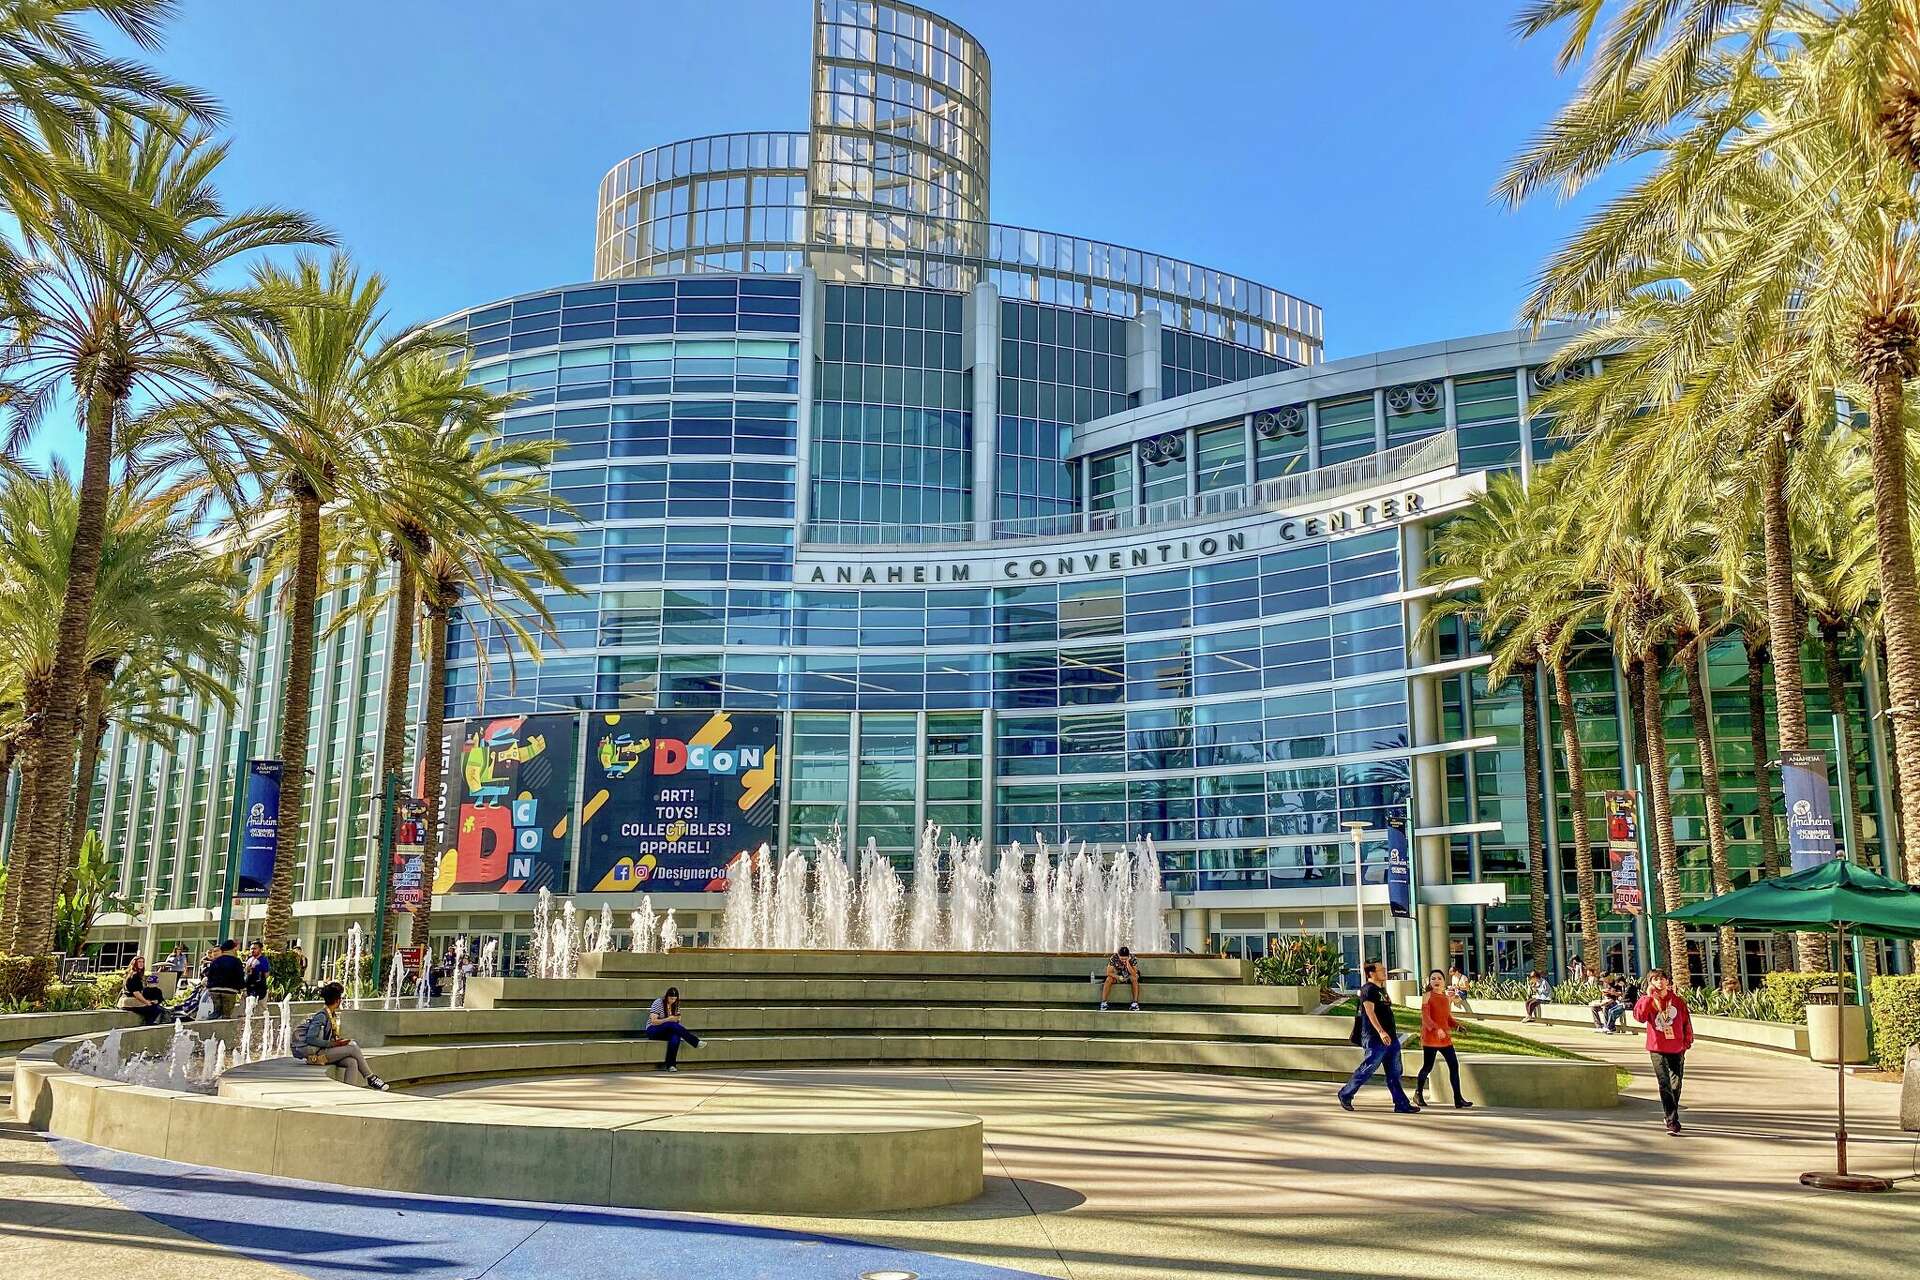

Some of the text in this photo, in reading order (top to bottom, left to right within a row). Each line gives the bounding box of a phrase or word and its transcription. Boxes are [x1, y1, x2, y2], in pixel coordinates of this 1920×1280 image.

[811, 492, 1419, 583] ANAHEIM CONVENTION CENTER
[653, 738, 760, 775] DCON
[661, 789, 695, 802] ART!
[656, 806, 698, 819] TOYS!
[246, 813, 278, 827] Anaheim
[1790, 812, 1832, 828] Anaheim
[621, 823, 731, 836] COLLECTIBLES!
[640, 841, 710, 854] APPAREL!
[652, 866, 726, 880] /DesignerCo
